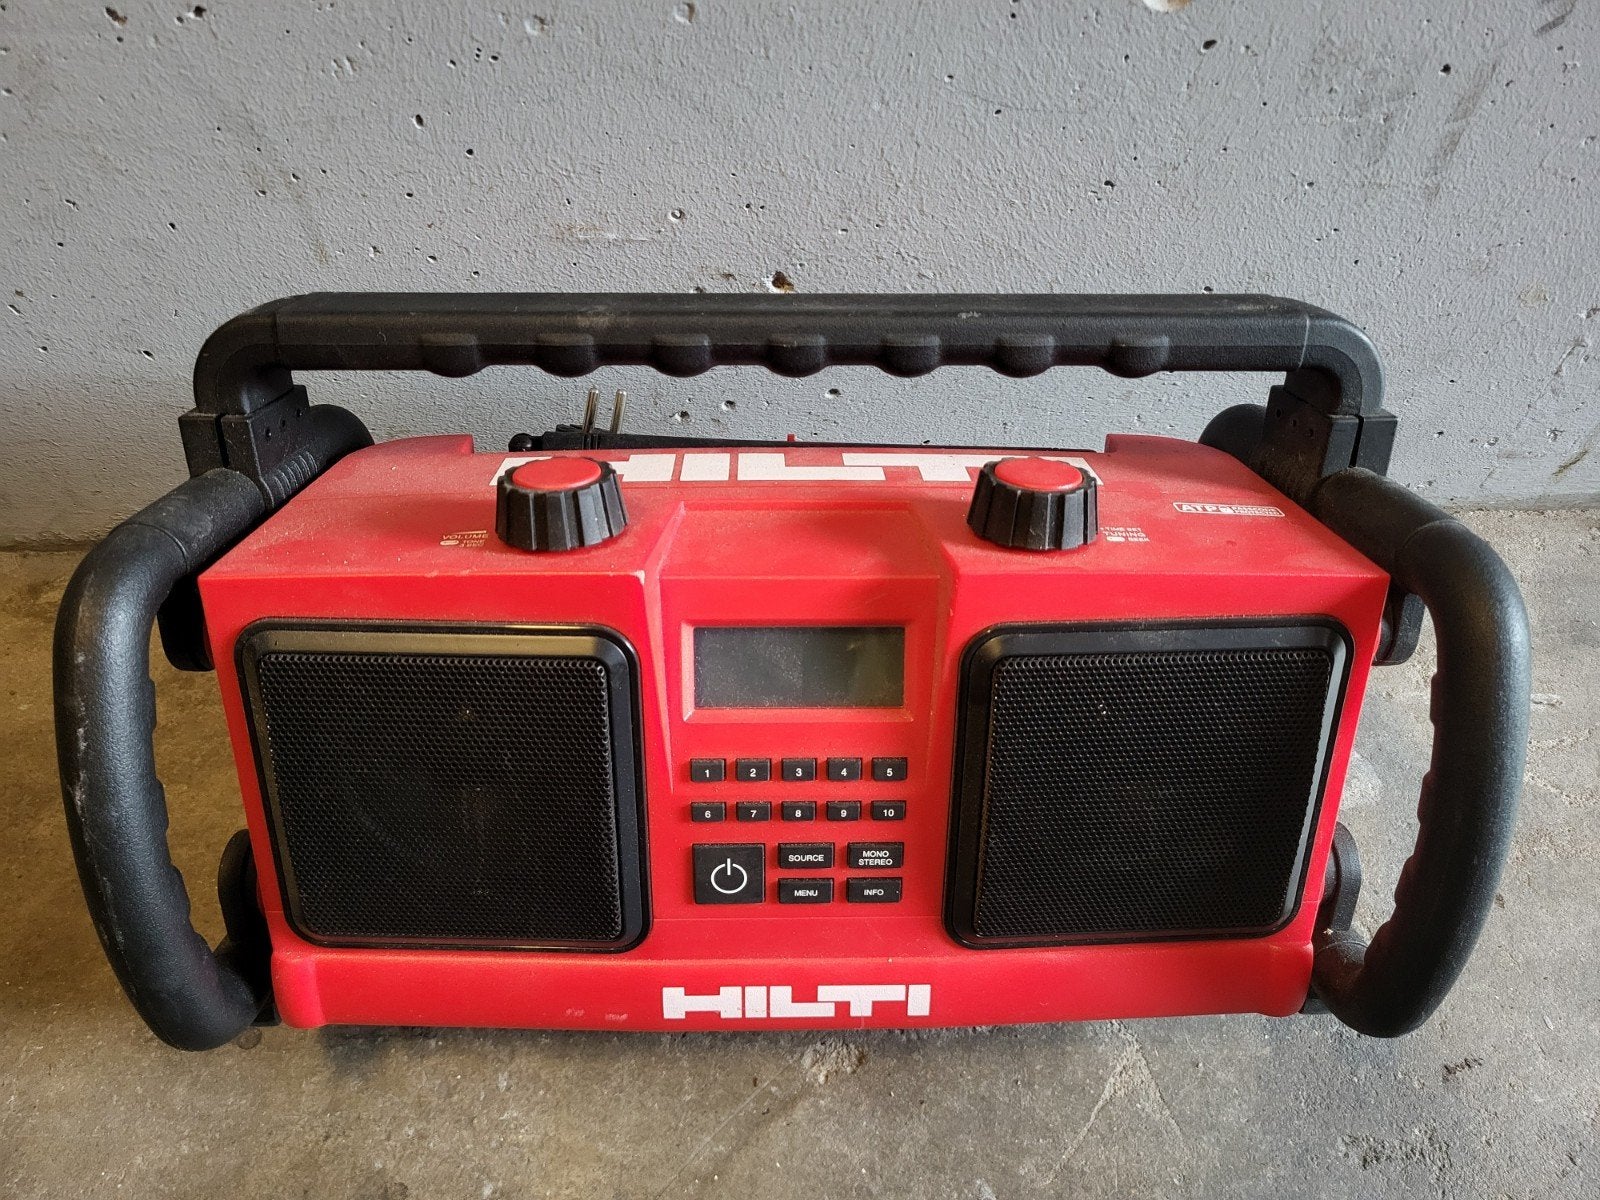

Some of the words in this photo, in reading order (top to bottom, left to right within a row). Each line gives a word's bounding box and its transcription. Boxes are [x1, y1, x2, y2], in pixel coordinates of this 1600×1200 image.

[704, 769, 710, 778] 1
[749, 768, 757, 777] 2
[795, 768, 802, 777] 3
[840, 768, 848, 777] 4
[886, 768, 893, 777] 5
[704, 810, 711, 819] 6
[750, 810, 757, 818] 7
[795, 809, 802, 818] 8
[840, 809, 847, 818] 9
[883, 809, 895, 817] 10
[788, 854, 825, 862] SOURCE
[862, 850, 889, 858] MONO
[858, 858, 893, 866] STEREO
[794, 889, 818, 897] MENU
[863, 888, 884, 896] INFO
[662, 984, 931, 1019] HILTI
